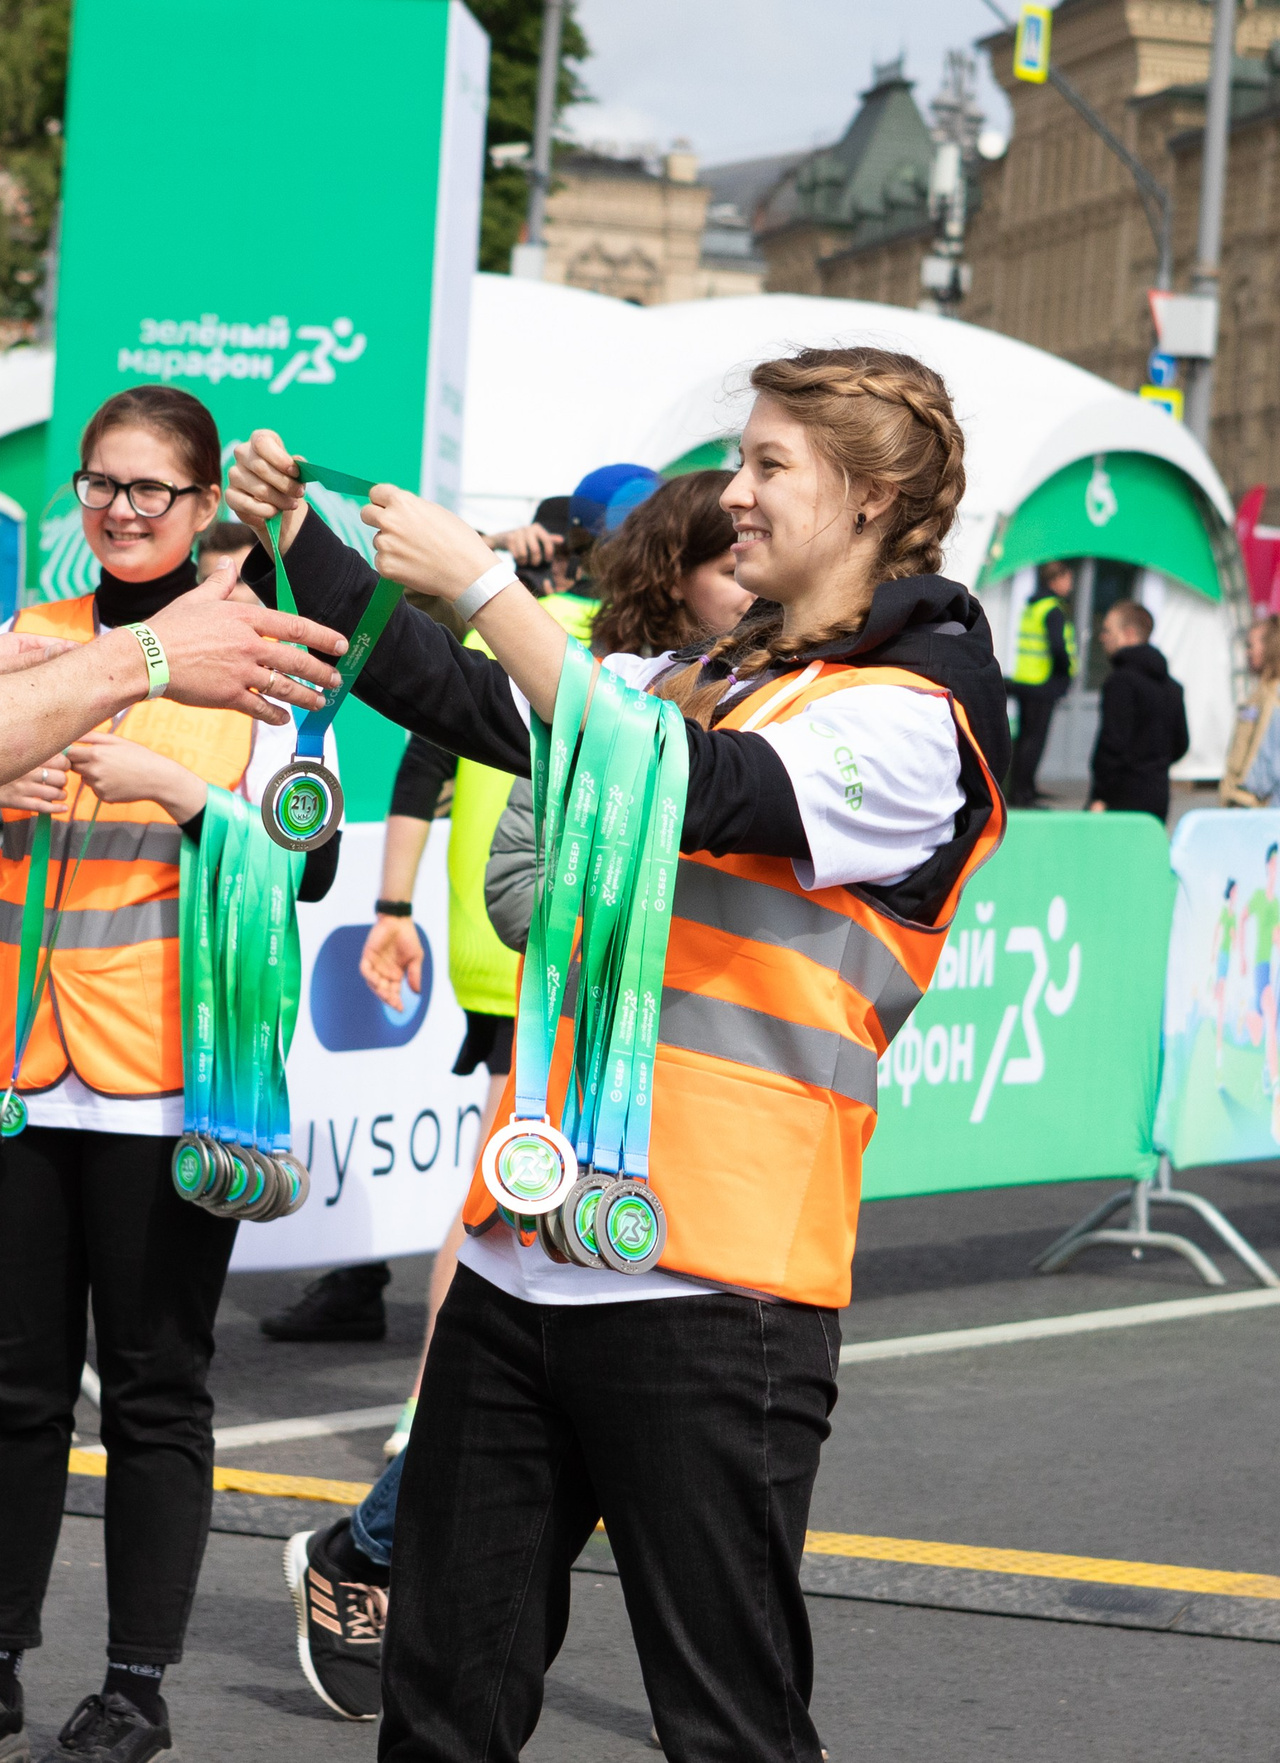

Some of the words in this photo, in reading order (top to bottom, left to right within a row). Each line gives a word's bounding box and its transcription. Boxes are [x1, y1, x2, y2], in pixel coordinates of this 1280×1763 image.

[118, 347, 273, 384] марафон
[834, 746, 863, 811] СБЕР
[291, 795, 318, 813] 21,1
[568, 842, 580, 871] СБЕР
[593, 854, 603, 882] СБЕР
[657, 868, 667, 897] СБЕР
[614, 1059, 625, 1088] СБЕР
[639, 1062, 647, 1091] СБЕР
